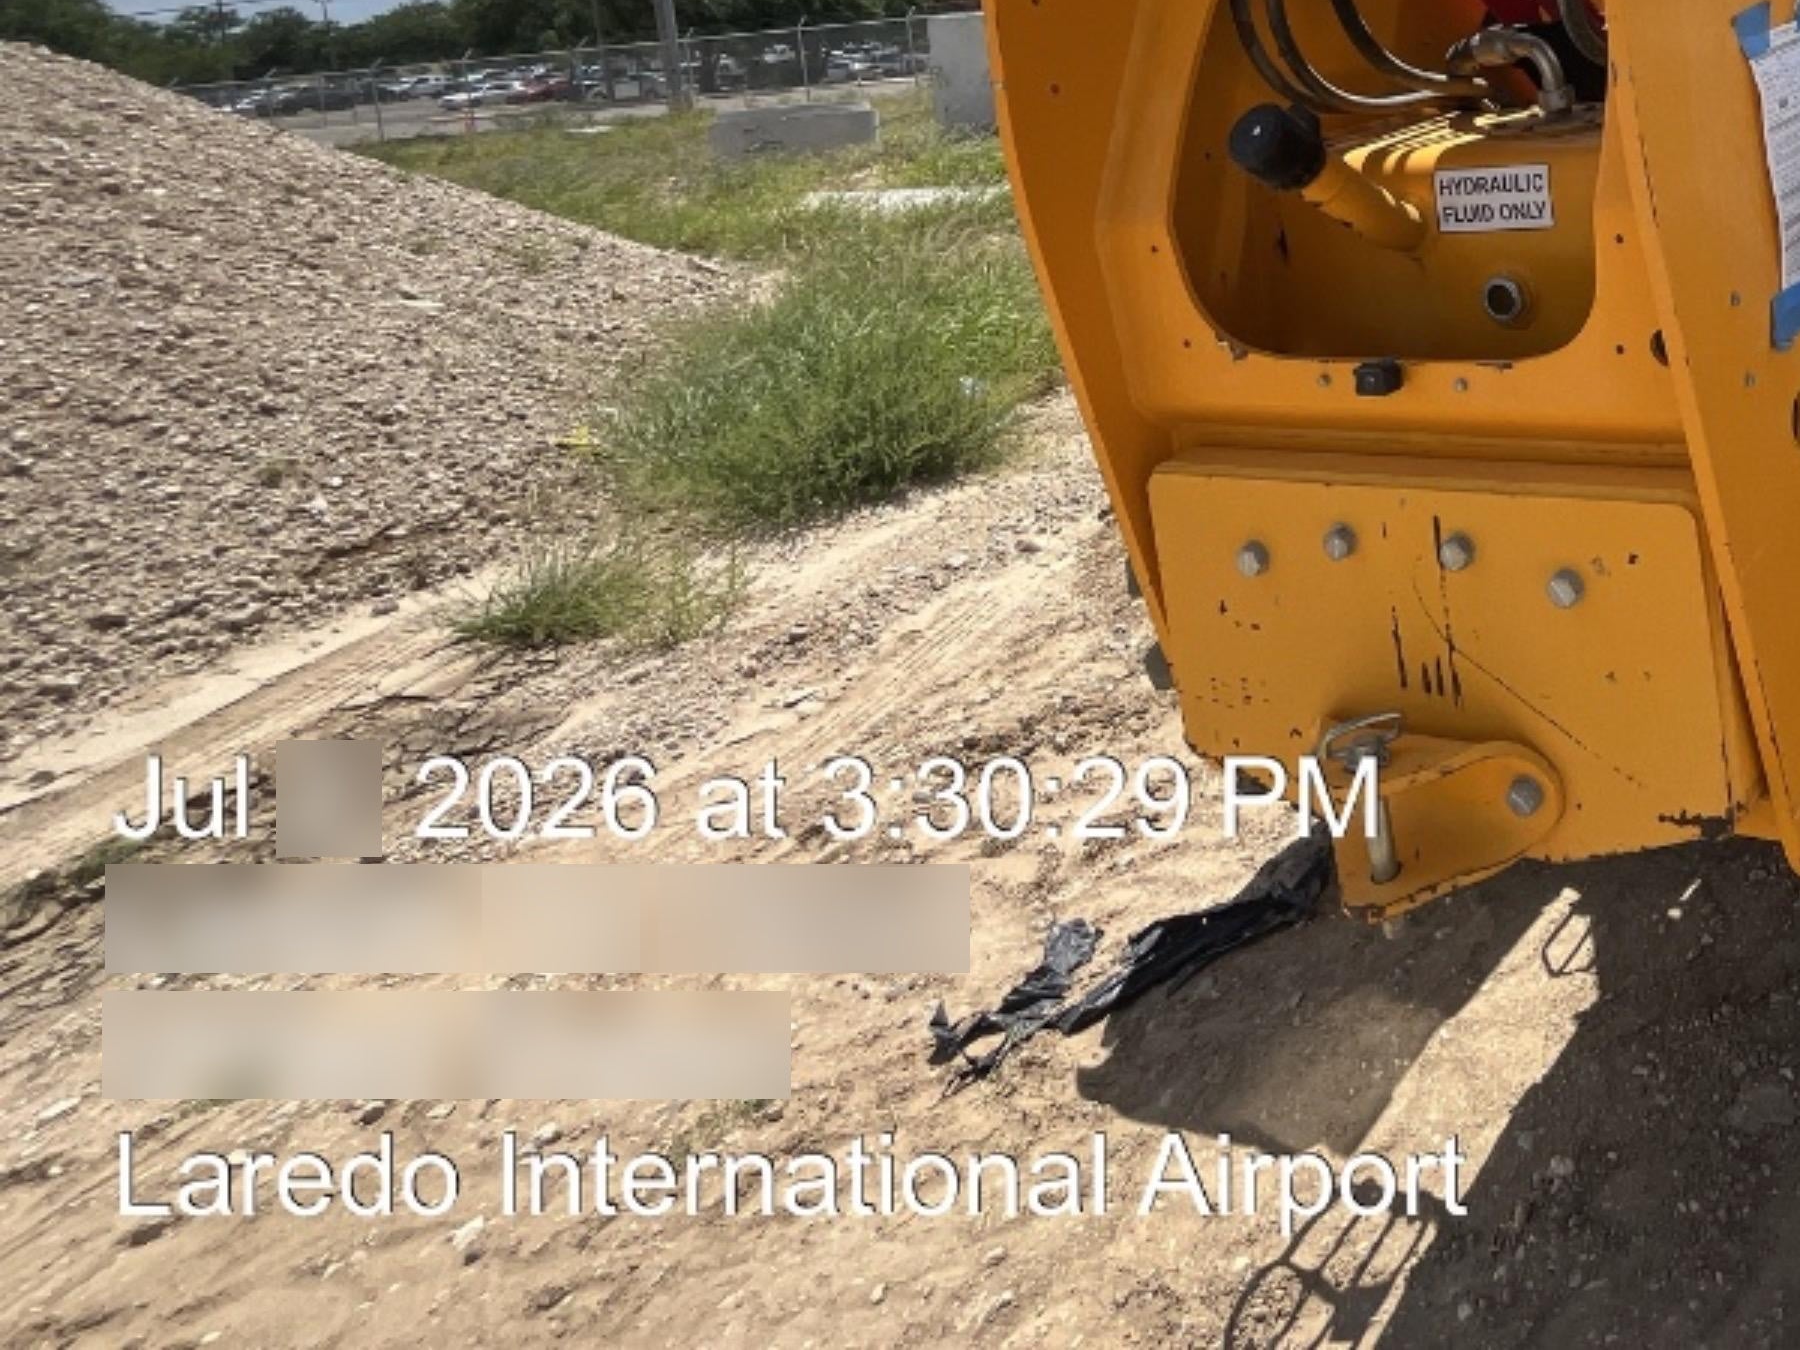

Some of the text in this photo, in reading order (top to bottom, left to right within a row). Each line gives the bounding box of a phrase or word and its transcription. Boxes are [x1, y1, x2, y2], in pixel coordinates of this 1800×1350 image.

[1438, 173, 1544, 196] HYDRAULIC
[1443, 200, 1546, 223] FLUID ONLY
